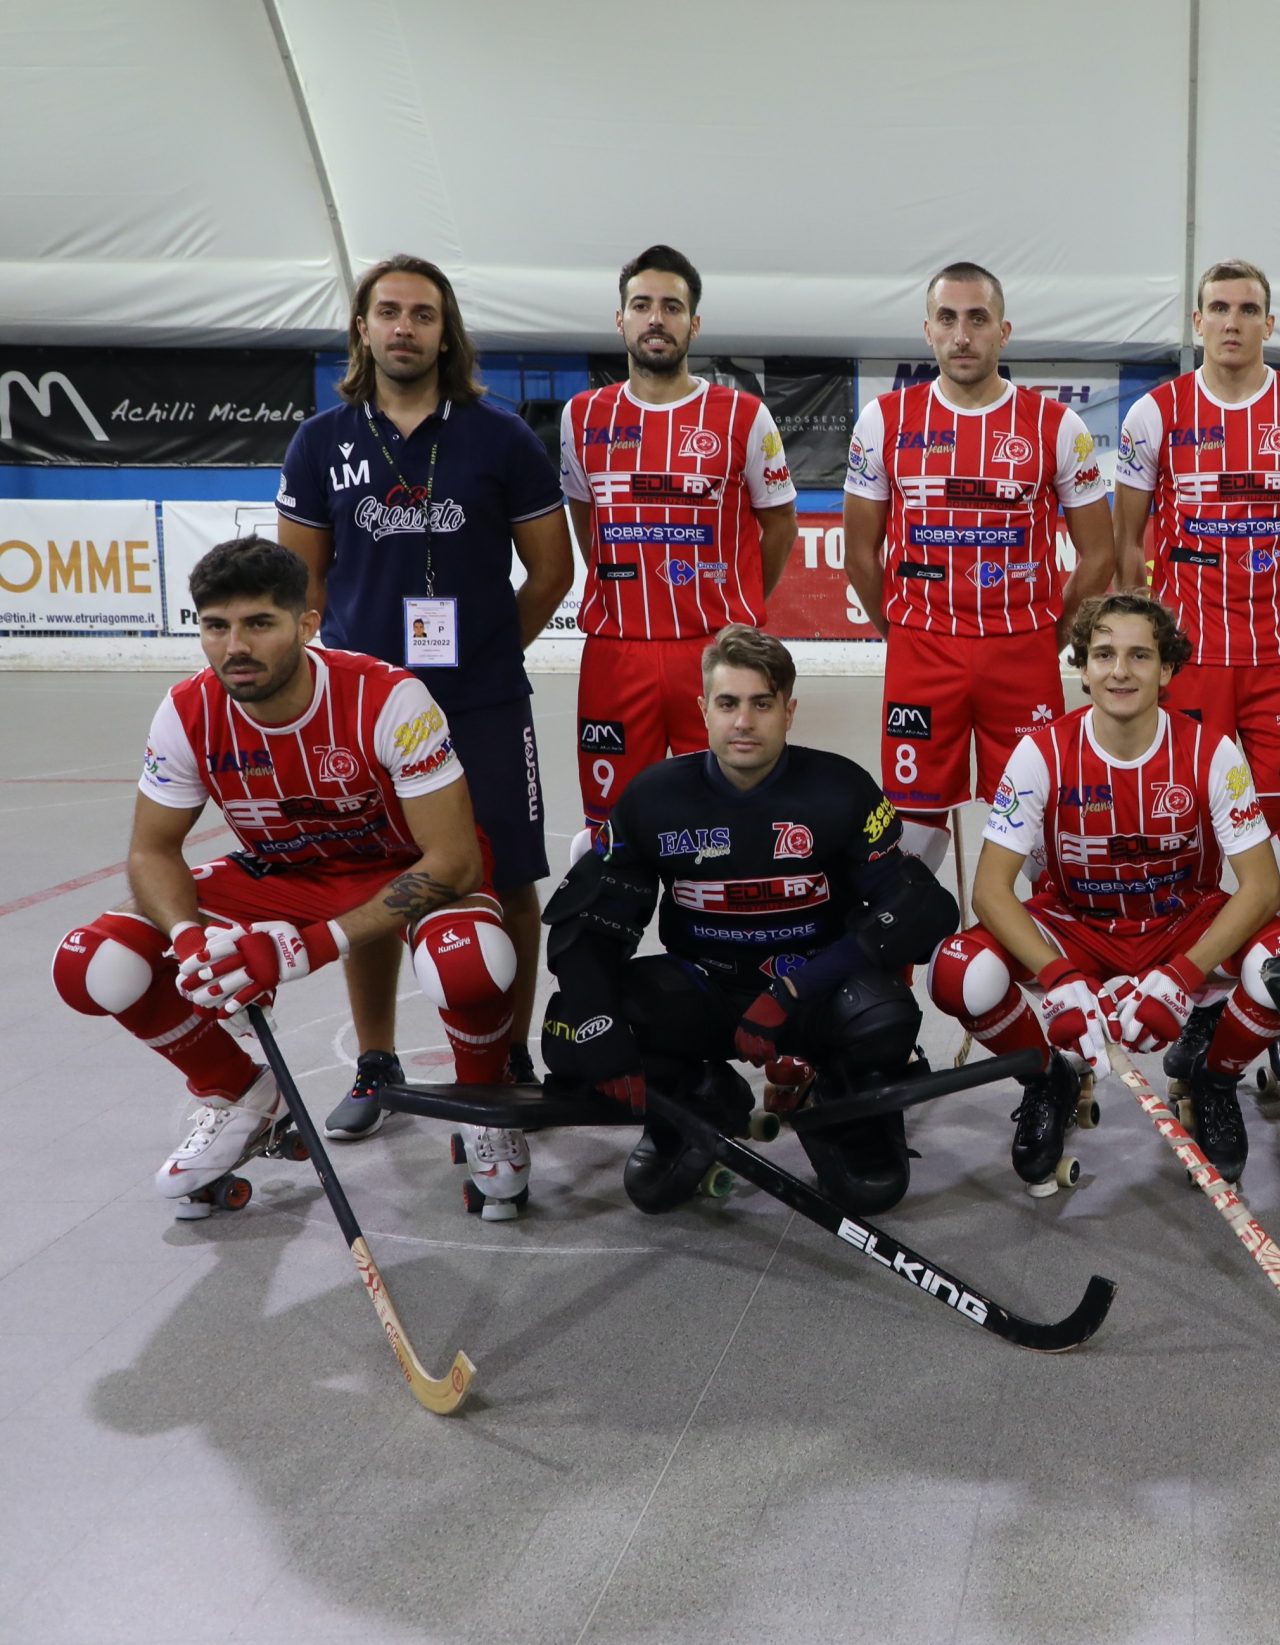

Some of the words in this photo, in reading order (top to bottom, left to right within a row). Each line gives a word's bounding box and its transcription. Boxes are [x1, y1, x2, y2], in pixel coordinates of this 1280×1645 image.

[111, 399, 195, 423] Achilli
[208, 402, 305, 423] Michele
[775, 415, 846, 424] GROSSETO
[584, 425, 642, 446] FAIS
[896, 430, 956, 449] FAIS
[1170, 426, 1224, 448] FAIS
[330, 460, 371, 491] LM
[604, 526, 706, 540] HOBBYSTORE
[915, 528, 1018, 541] HOBBYSTORE
[47, 613, 155, 626] www.etruriagomme.it
[438, 625, 445, 633] P
[1014, 725, 1043, 734] ROSATI
[523, 726, 539, 822] macron
[895, 743, 918, 784] 8
[593, 758, 615, 798] 9
[657, 827, 731, 857] FAIS
[772, 821, 814, 860] 70
[1077, 870, 1185, 892] HOBBYSTORE
[593, 914, 621, 930] TVD
[693, 922, 816, 940] HOBBYSTORE
[276, 932, 296, 969] Kumbre
[1162, 992, 1190, 1018] Kumbre
[580, 1020, 607, 1040] TVD
[836, 1216, 989, 1326] ELKING
